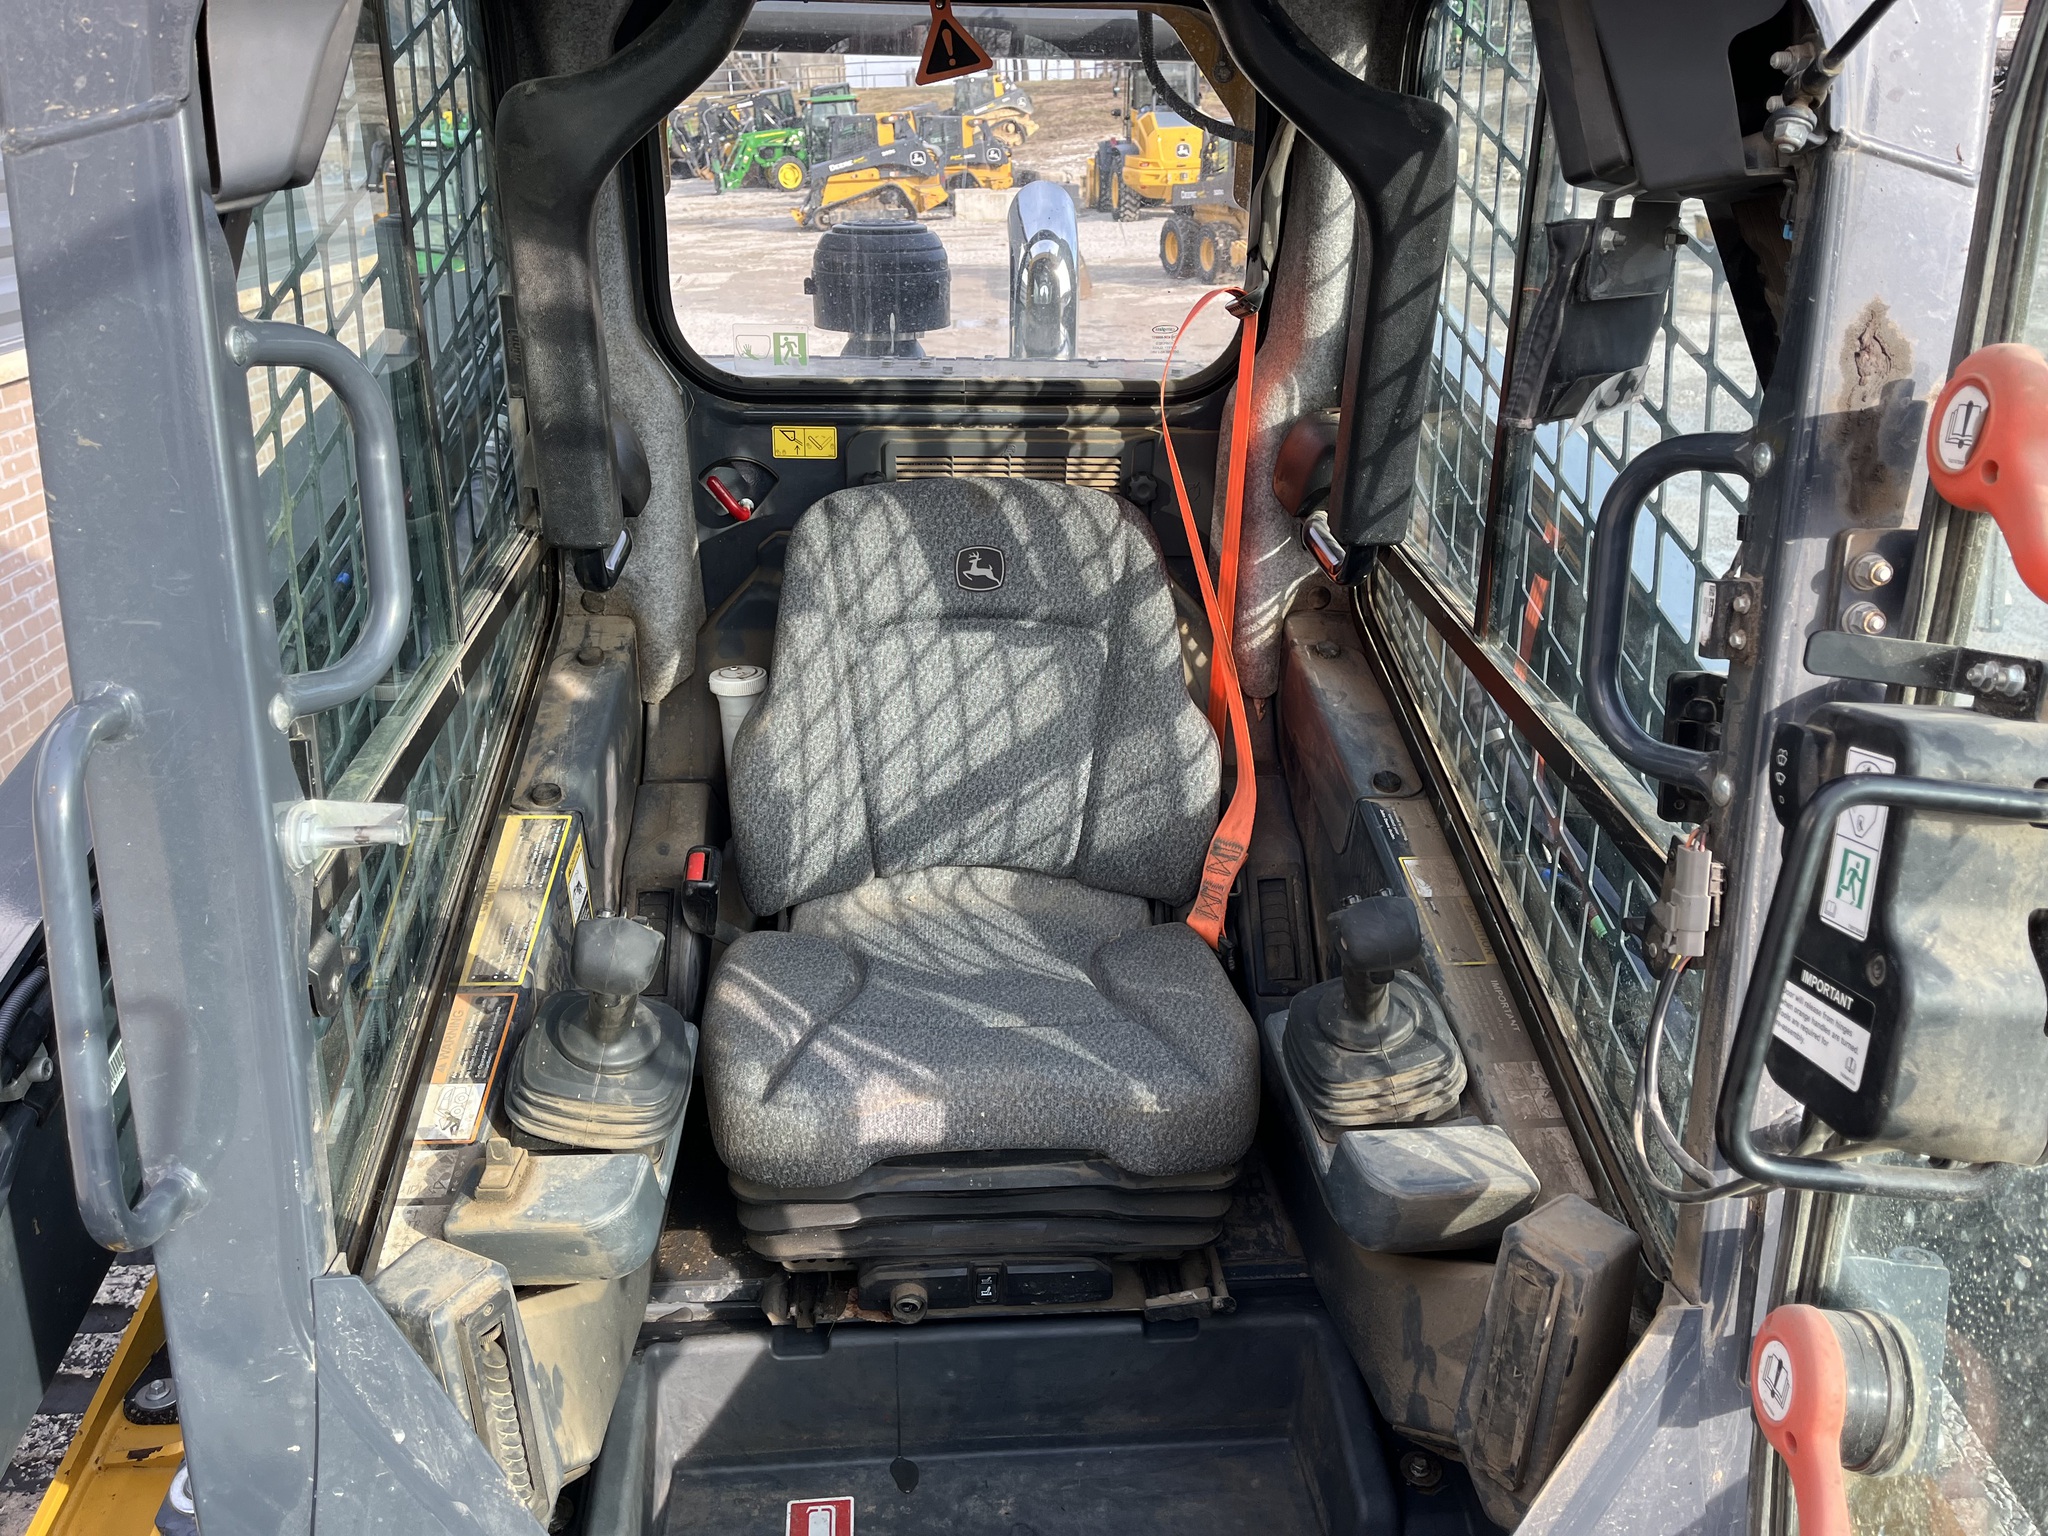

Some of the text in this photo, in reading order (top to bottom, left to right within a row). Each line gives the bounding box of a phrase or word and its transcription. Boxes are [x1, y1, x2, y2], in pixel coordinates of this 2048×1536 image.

[1490, 979, 1521, 1033] IMPORTANT
[1800, 969, 1854, 1011] IMPORTANT
[440, 1010, 464, 1061] WARNING
[1793, 1006, 1810, 1023] orange
[1810, 1016, 1831, 1035] handles
[1799, 1022, 1821, 1042] required
[1803, 1000, 1821, 1016] release
[1833, 1018, 1853, 1038] hinges
